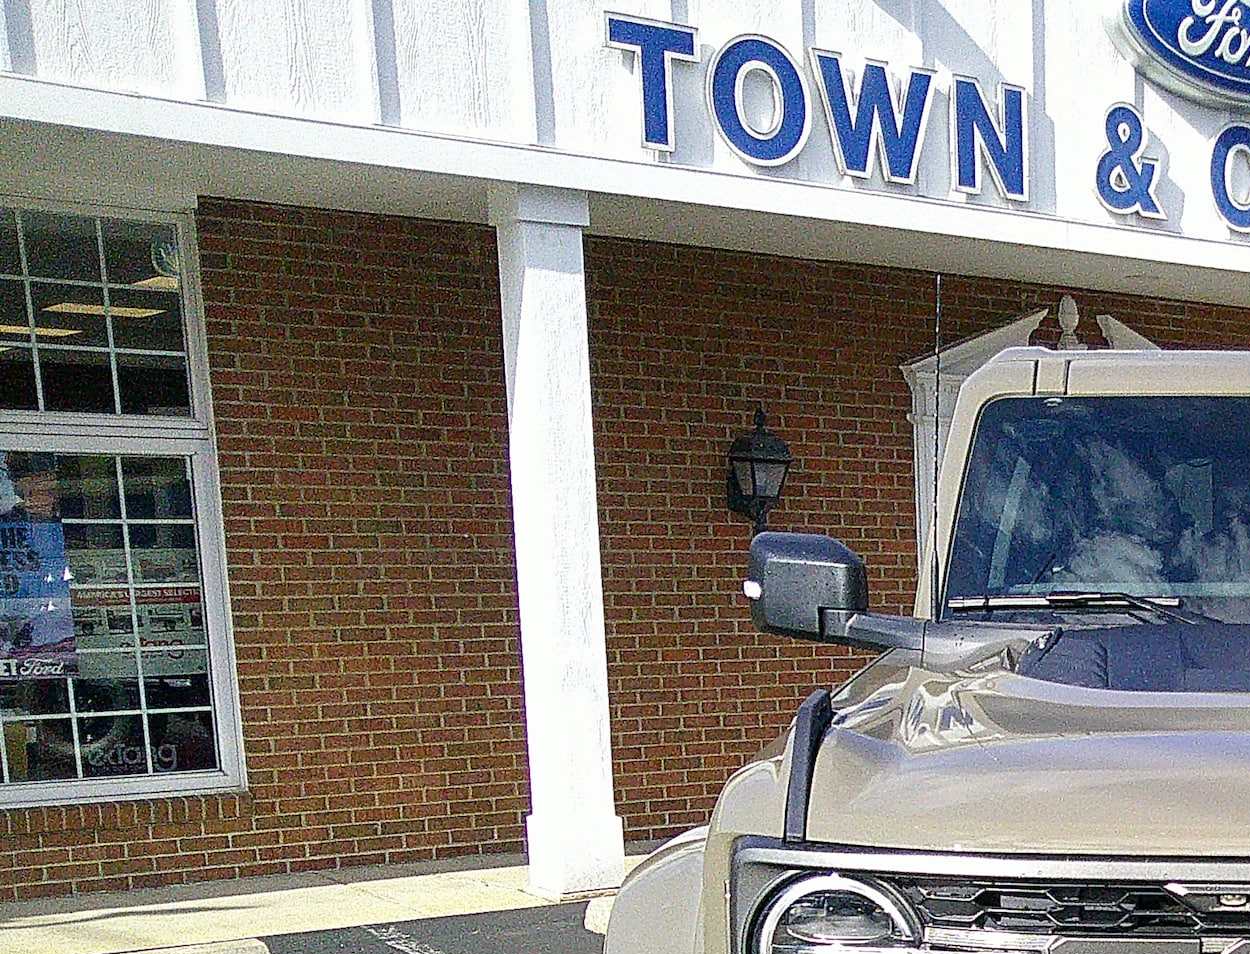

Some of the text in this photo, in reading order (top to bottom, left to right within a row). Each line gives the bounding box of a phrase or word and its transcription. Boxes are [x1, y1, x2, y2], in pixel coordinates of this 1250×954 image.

[604, 10, 1030, 202] TOWN
[1093, 101, 1168, 220] &
[20, 658, 65, 676] Ford
